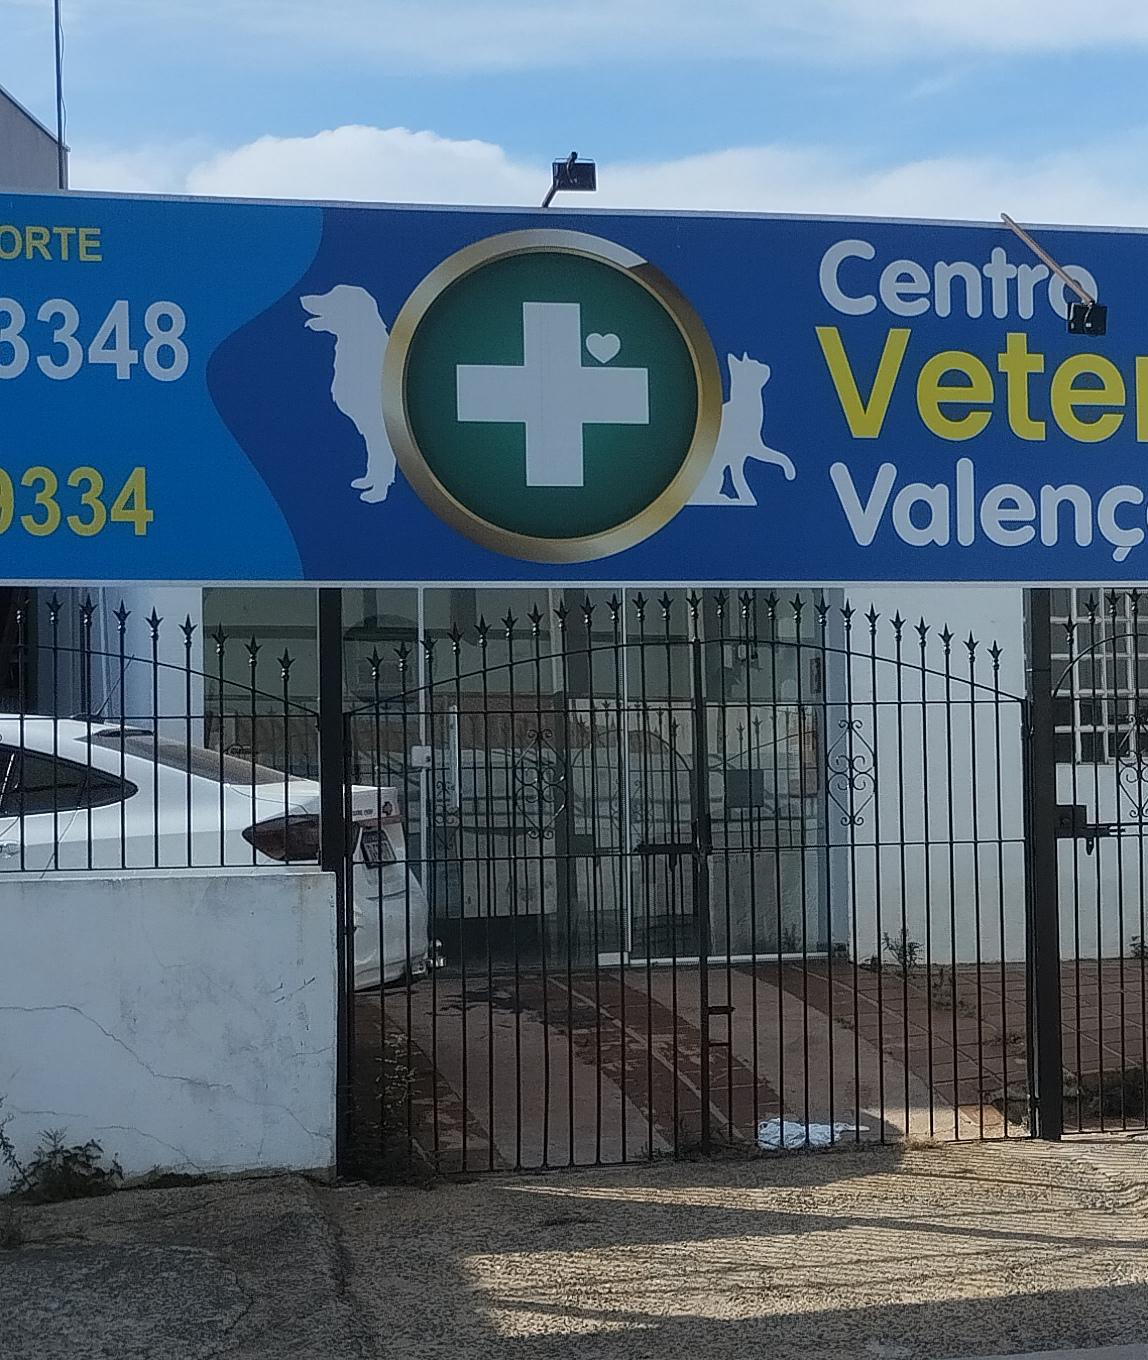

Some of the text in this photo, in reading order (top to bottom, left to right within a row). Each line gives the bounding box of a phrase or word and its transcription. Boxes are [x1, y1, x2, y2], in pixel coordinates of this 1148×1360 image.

[0, 225, 102, 261] ORTE
[819, 240, 1098, 321] Centro
[0, 297, 189, 381] 3348
